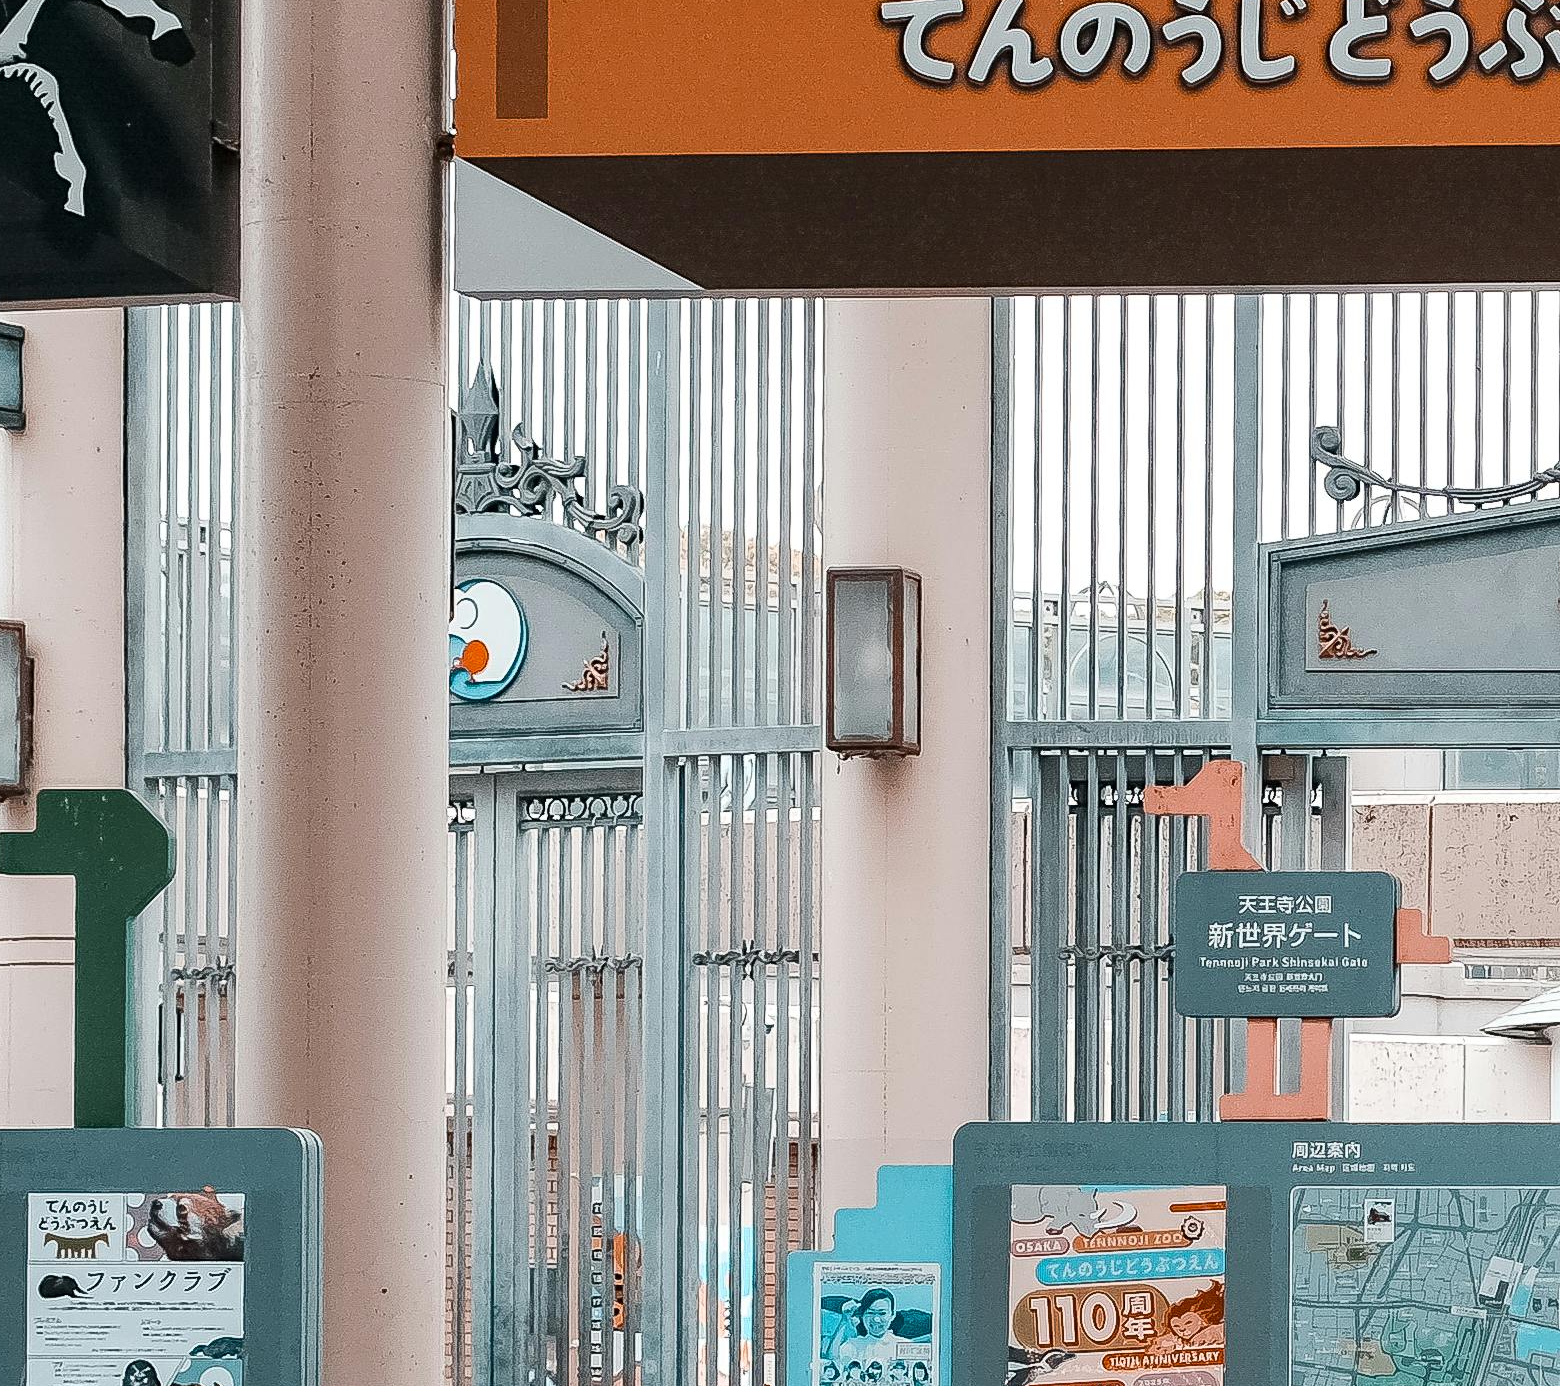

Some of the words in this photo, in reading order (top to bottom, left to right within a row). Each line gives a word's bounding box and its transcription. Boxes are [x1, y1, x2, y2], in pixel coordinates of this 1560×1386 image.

[1238, 895, 1332, 914] 天王寺公園
[1208, 922, 1361, 949] 新世界ゲート
[1251, 957, 1280, 968] Park
[1292, 1141, 1361, 1159] 周辺案内
[45, 1198, 109, 1215] てんのうじ
[38, 1215, 117, 1231] どうぶつえん
[1015, 1240, 1062, 1253] OSAKA
[1047, 1256, 1219, 1279] てんのうじどうぶつえん
[86, 1266, 233, 1293] ファンクラブ
